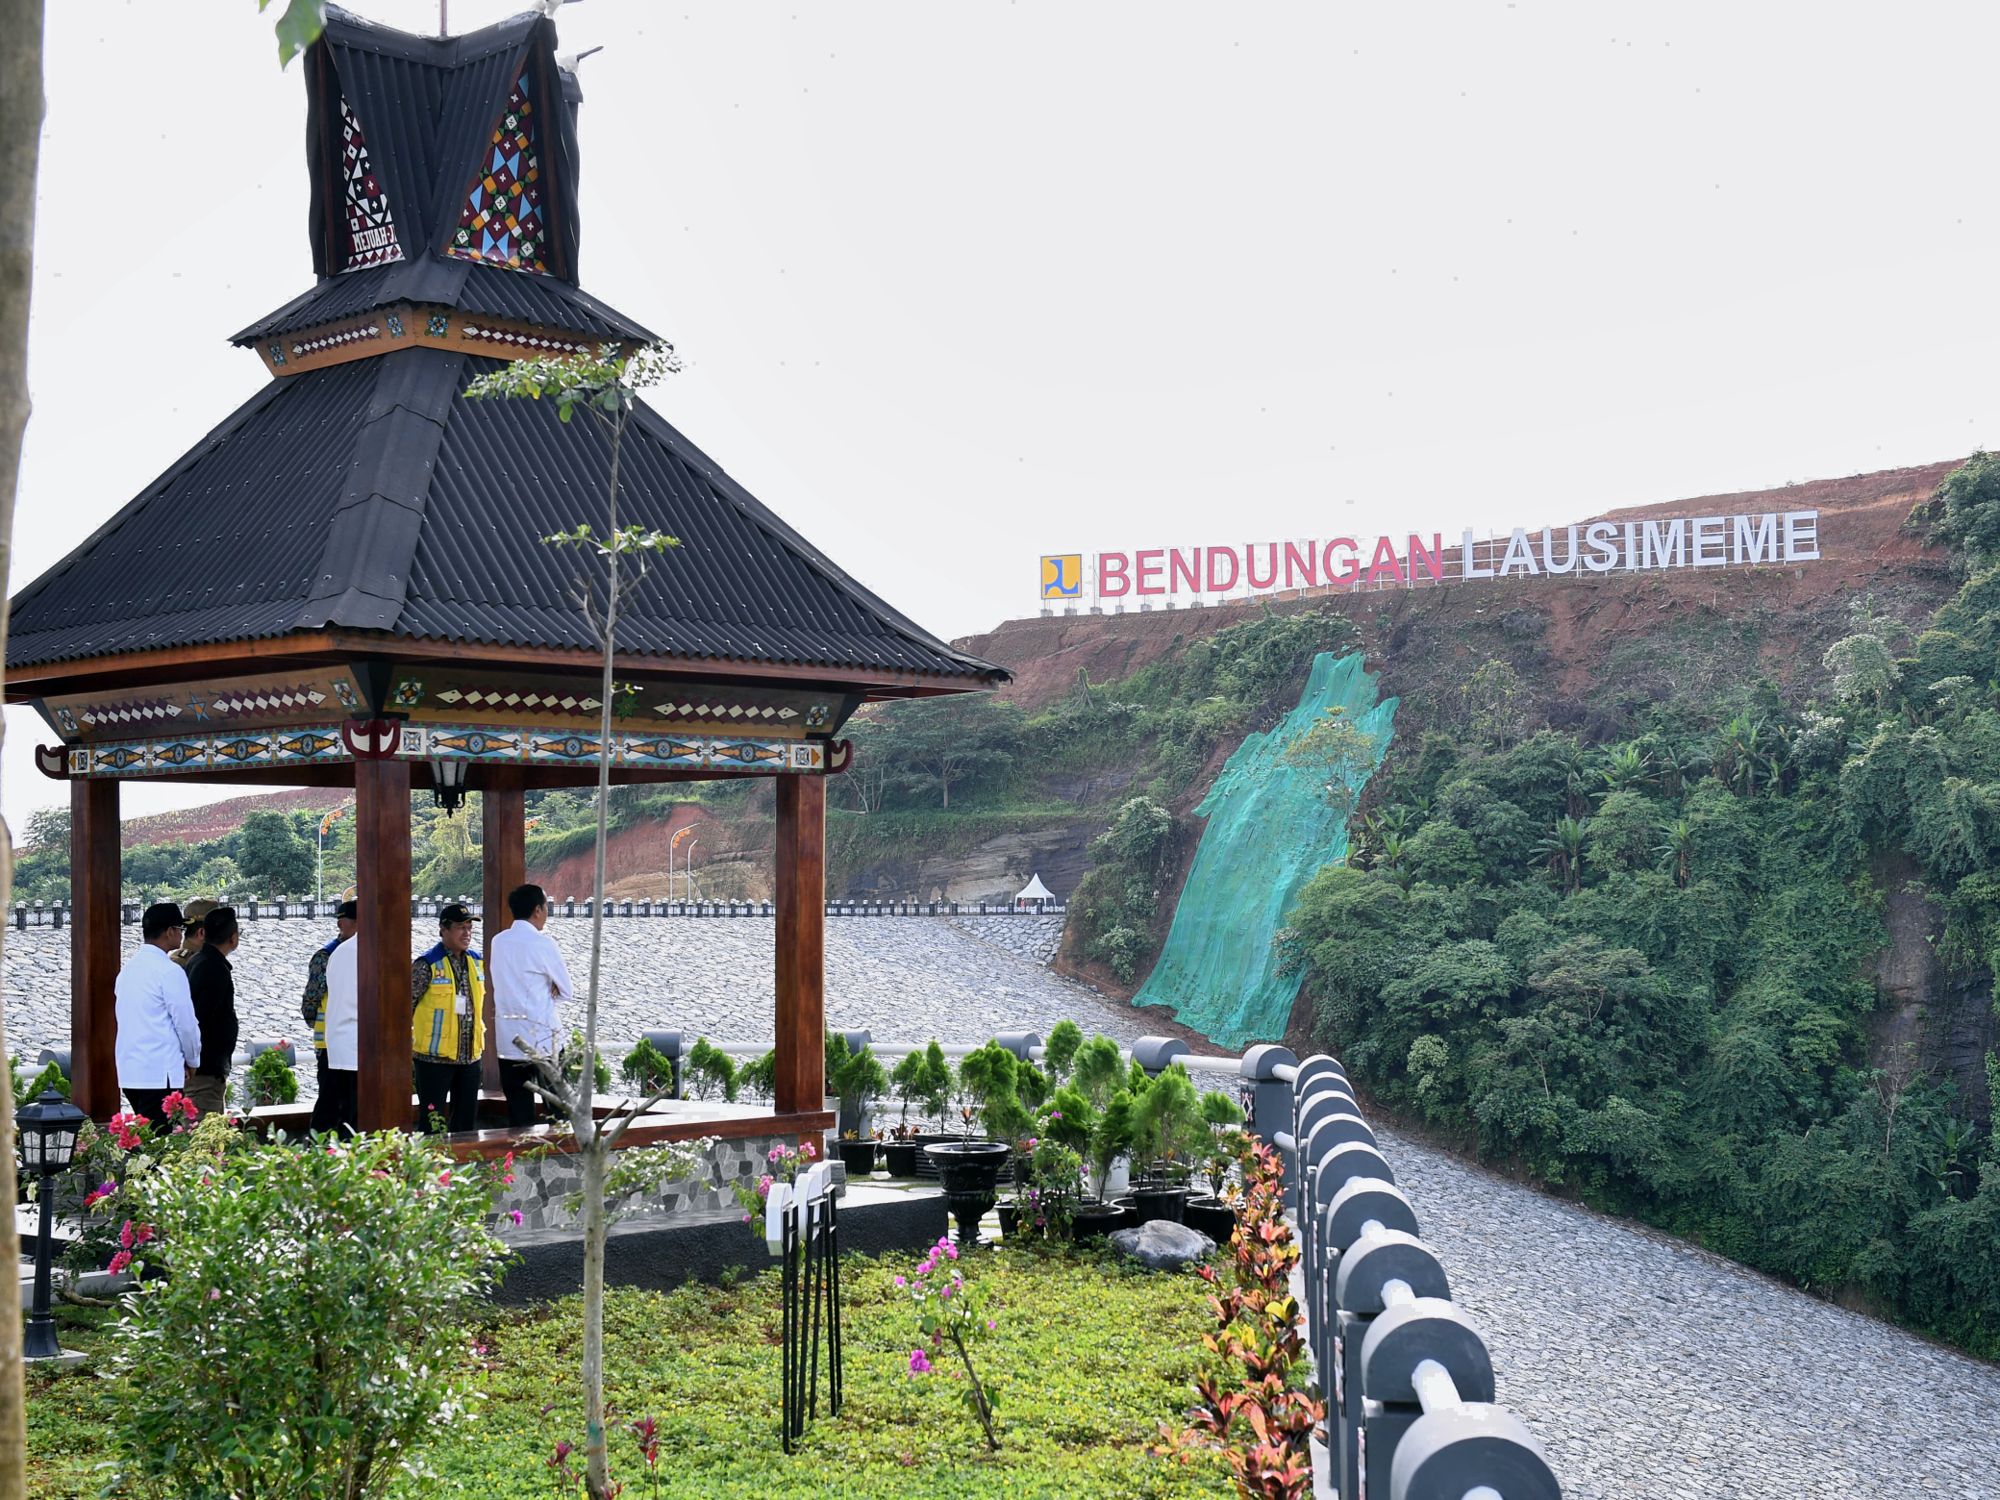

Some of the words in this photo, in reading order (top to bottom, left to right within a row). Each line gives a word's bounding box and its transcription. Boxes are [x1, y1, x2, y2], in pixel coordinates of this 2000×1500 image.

[352, 224, 397, 252] MEJUAH-J
[1099, 533, 1442, 598] BENDUNGAN
[1463, 510, 1820, 579] LAUSIMEME
